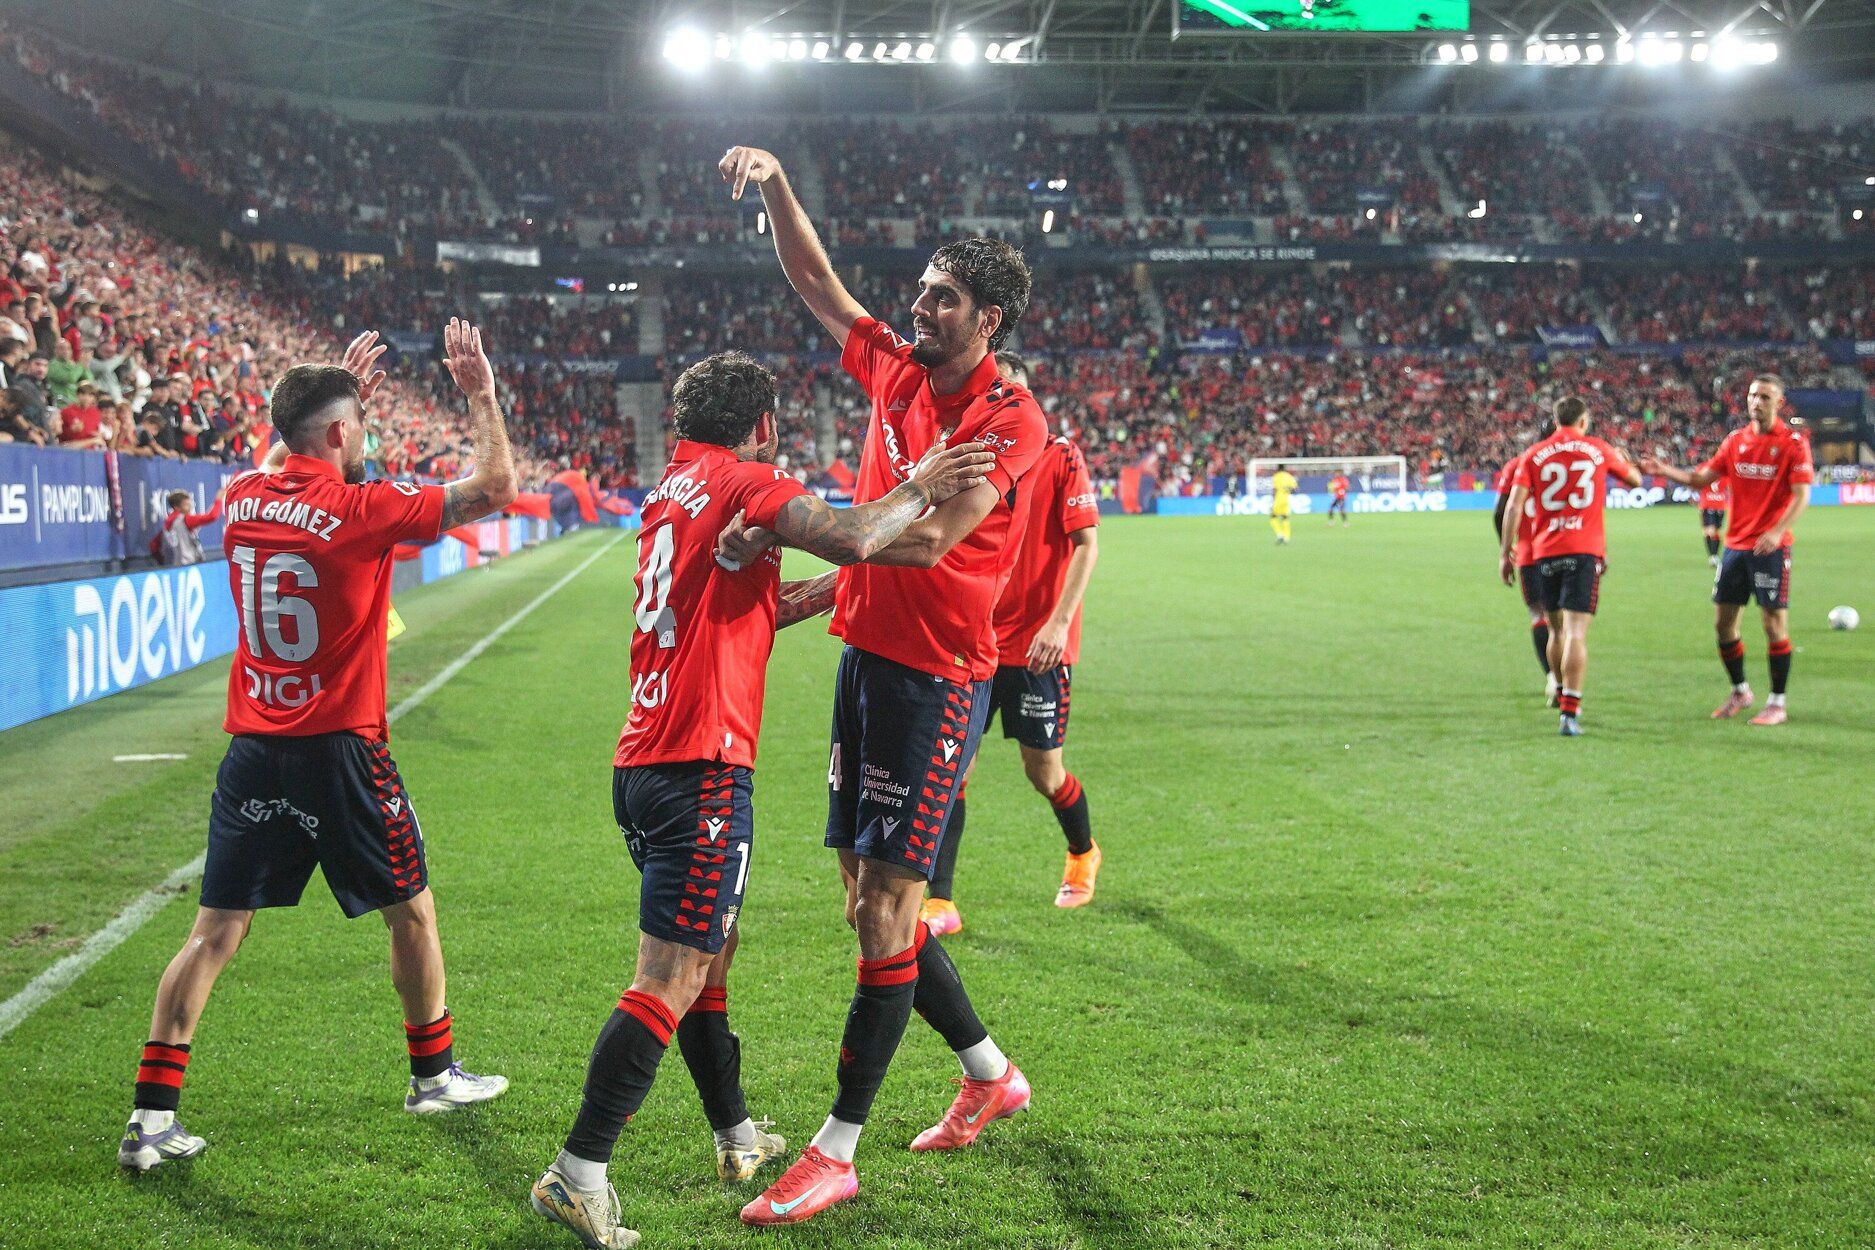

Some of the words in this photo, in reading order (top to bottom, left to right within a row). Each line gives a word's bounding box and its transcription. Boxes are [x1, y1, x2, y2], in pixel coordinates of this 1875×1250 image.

[1259, 248, 1275, 260] SE
[1277, 247, 1316, 260] RINDE
[1541, 461, 1595, 512] 23
[227, 497, 259, 528] MOI
[261, 496, 343, 542] GÓMEZ
[231, 544, 320, 663] 16
[636, 522, 676, 649] 4
[66, 566, 206, 703] moeve
[245, 665, 323, 708] DIGI
[631, 669, 670, 709] IGI
[863, 776, 910, 797] Universidad
[864, 764, 890, 779] Clínica
[870, 790, 903, 808] Navarra
